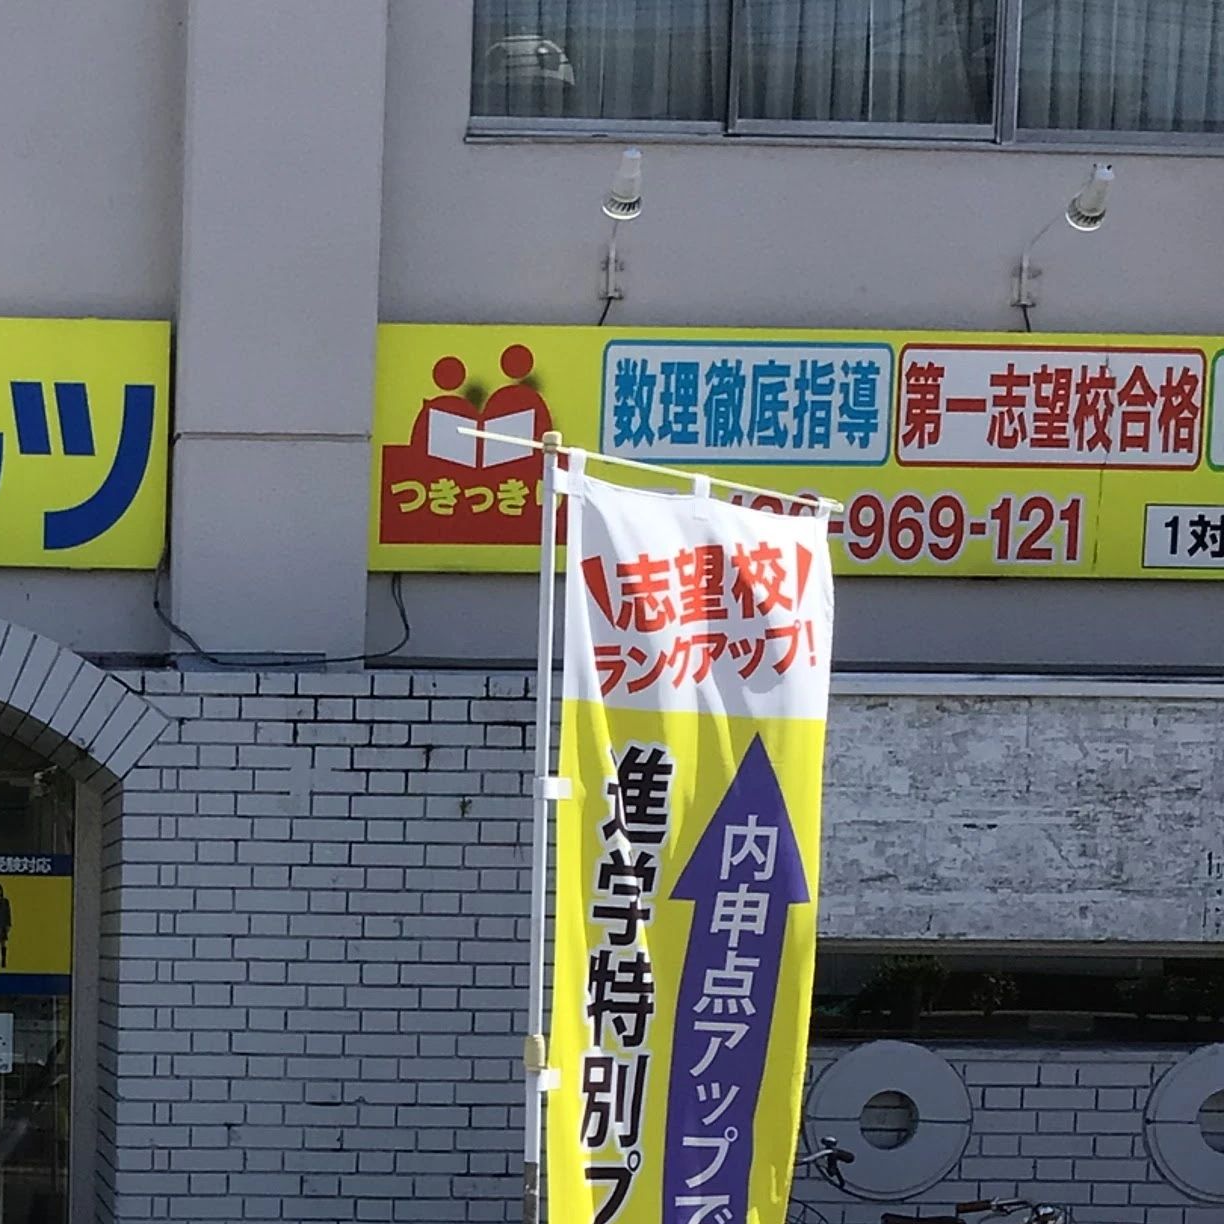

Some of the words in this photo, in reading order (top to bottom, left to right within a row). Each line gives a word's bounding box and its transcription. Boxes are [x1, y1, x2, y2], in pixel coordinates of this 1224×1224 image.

[614, 358, 881, 450] 数理徹底指導
[902, 361, 1200, 454] 第一志望校合格
[616, 541, 793, 633] 志望校
